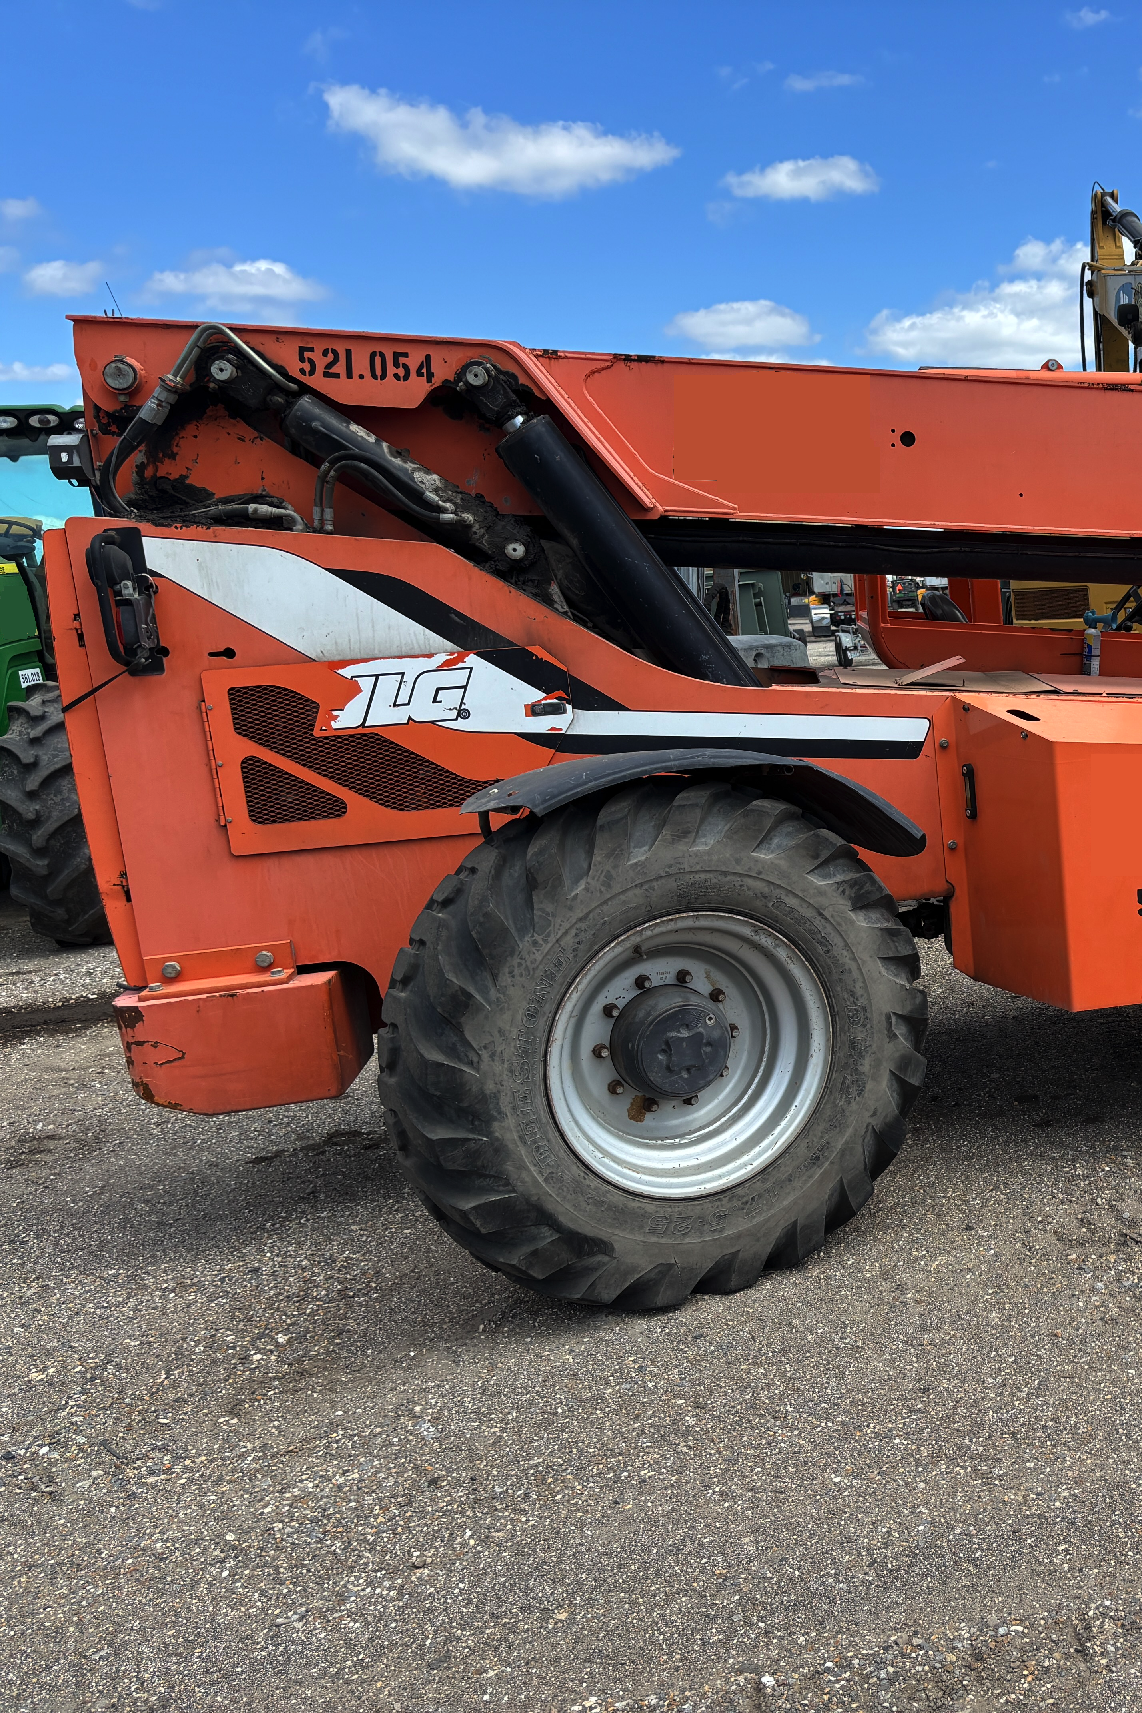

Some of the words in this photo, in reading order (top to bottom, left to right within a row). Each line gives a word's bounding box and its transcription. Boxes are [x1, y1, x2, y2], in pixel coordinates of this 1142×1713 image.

[298, 345, 436, 384] 521.054
[320, 667, 473, 731] JLG
[512, 946, 571, 1169] DEESTONE
